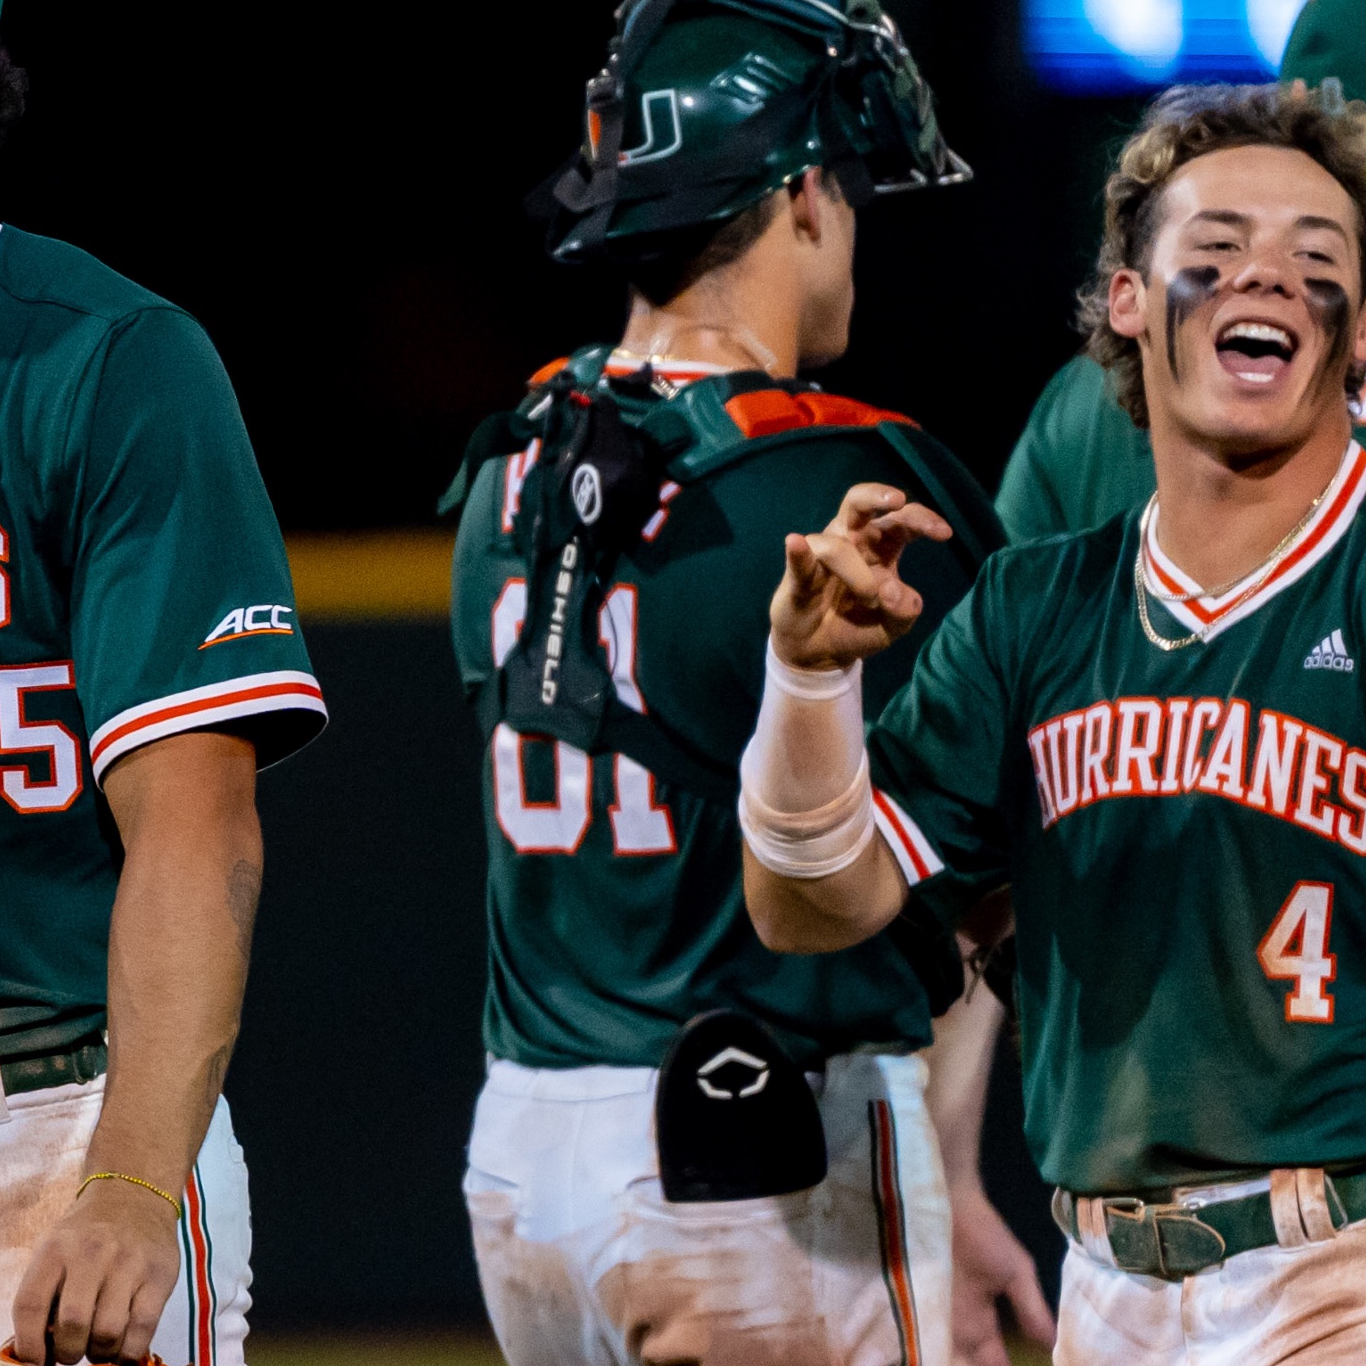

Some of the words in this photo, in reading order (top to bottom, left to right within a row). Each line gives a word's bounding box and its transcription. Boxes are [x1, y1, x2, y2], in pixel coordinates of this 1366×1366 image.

[204, 604, 293, 643] ACC
[542, 537, 579, 707] OSHIELD
[1303, 651, 1355, 672] adidas
[1256, 880, 1337, 1023] 4
